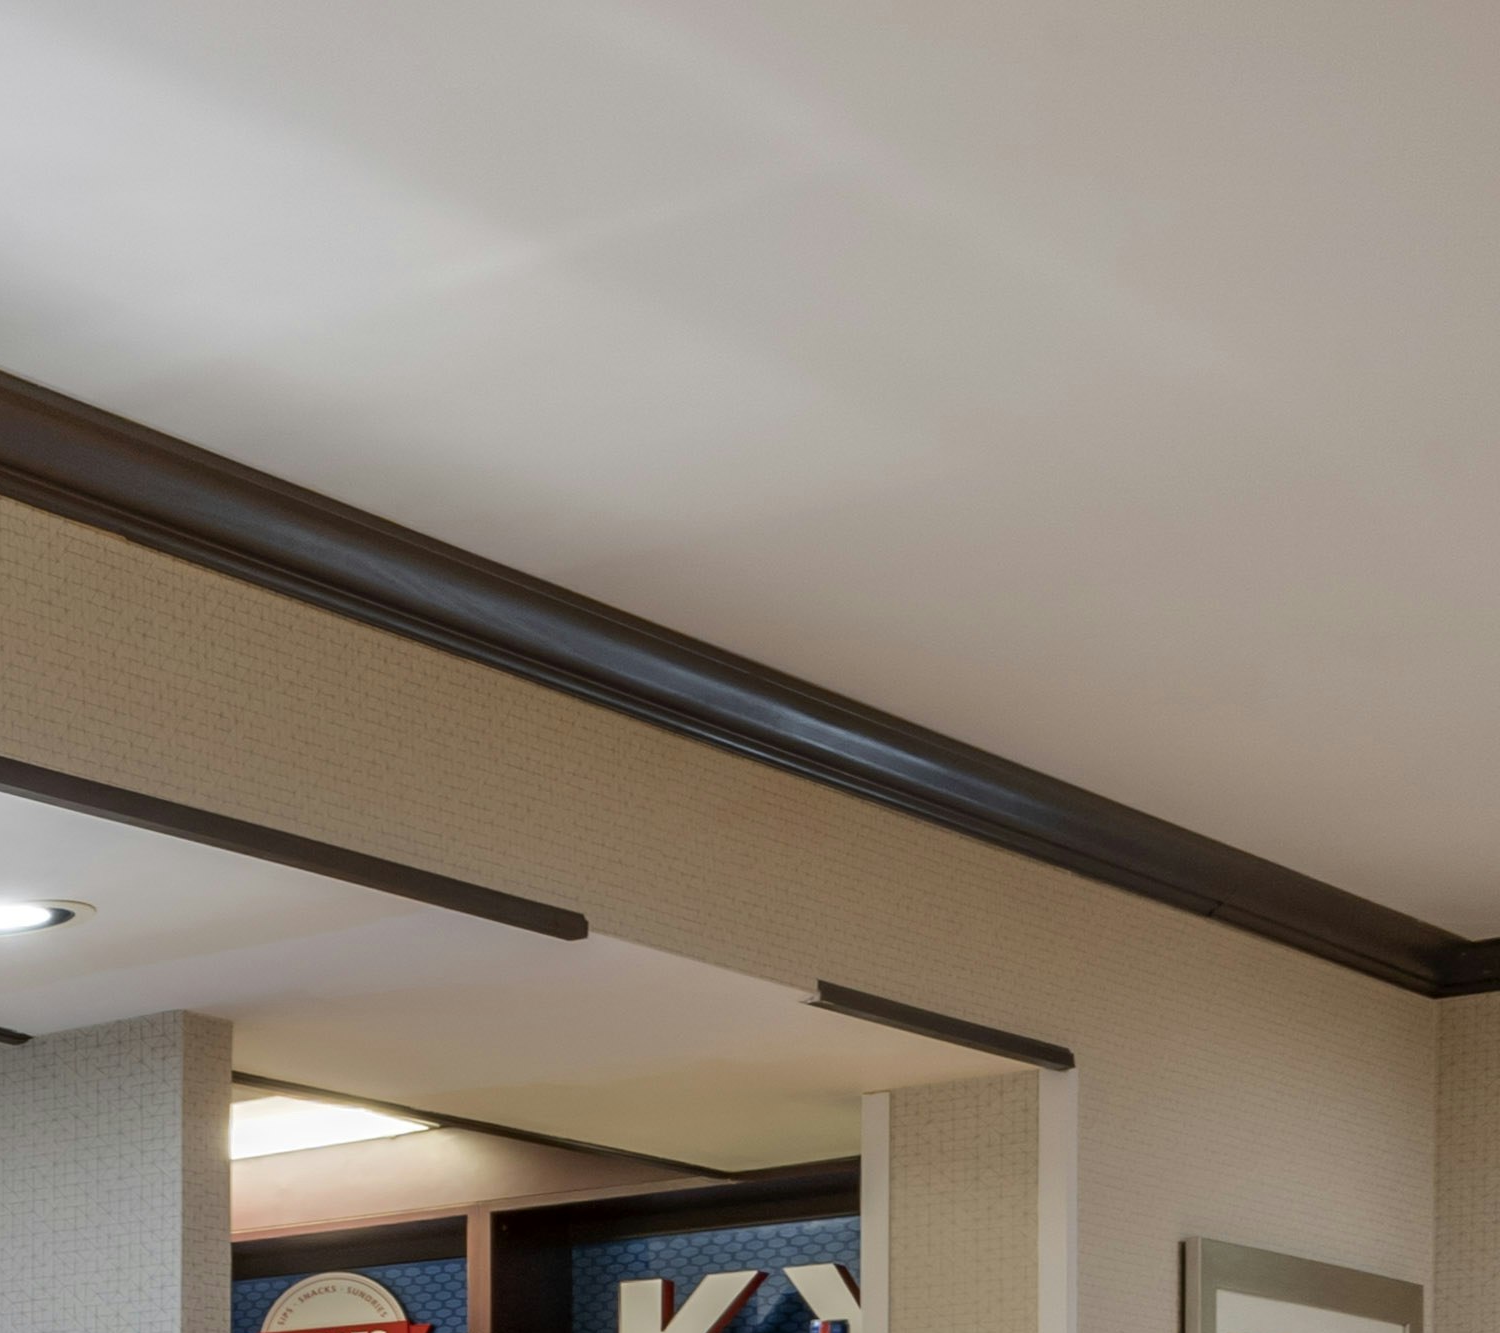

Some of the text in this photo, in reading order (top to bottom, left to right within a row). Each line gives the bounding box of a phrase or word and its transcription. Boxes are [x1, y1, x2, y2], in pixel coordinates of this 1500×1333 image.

[277, 1285, 387, 1326] SIPS SNACKS SUNDRIES
